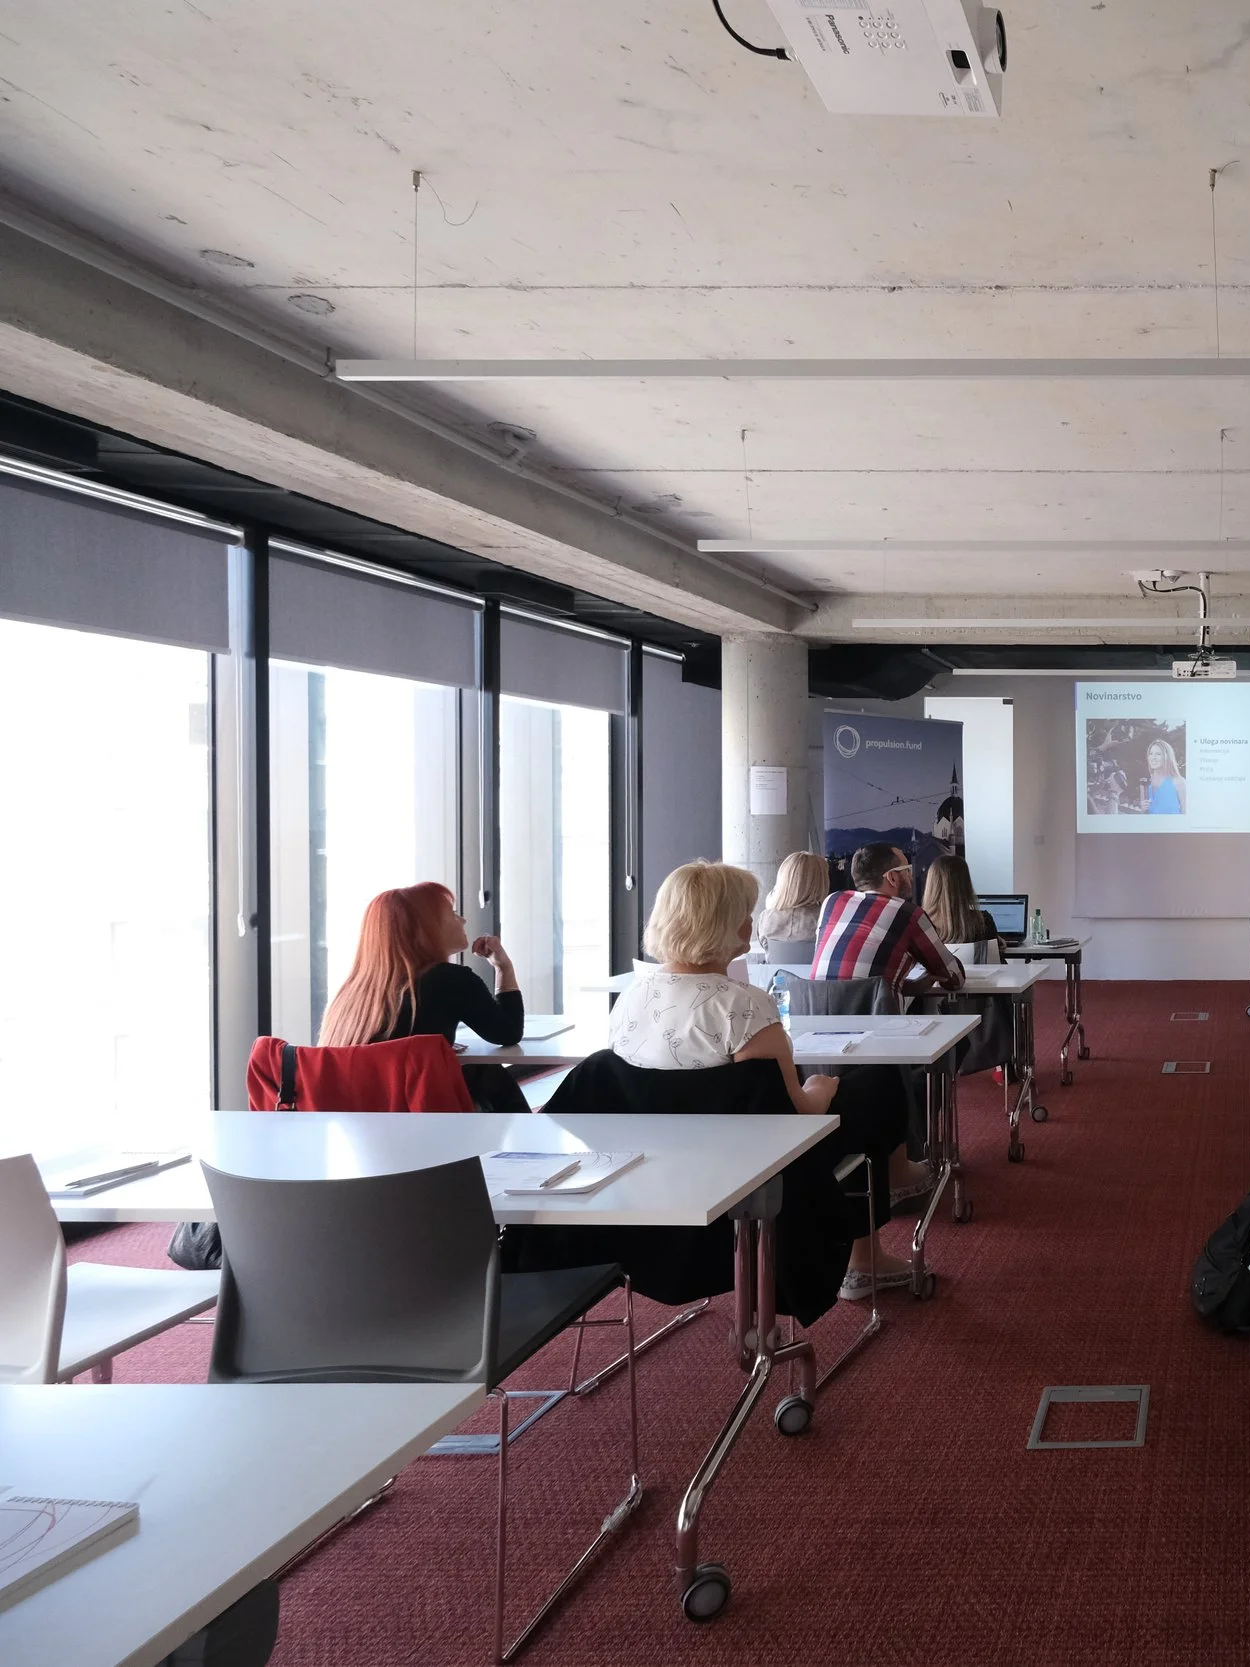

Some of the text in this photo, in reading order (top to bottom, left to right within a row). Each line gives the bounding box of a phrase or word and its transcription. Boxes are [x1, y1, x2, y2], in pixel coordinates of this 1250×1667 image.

[825, 14, 850, 54] Panasonic
[1086, 692, 1142, 701] Novinarstvo
[865, 739, 923, 751] propulsion.fund
[1199, 737, 1249, 747] Uloga novinara
